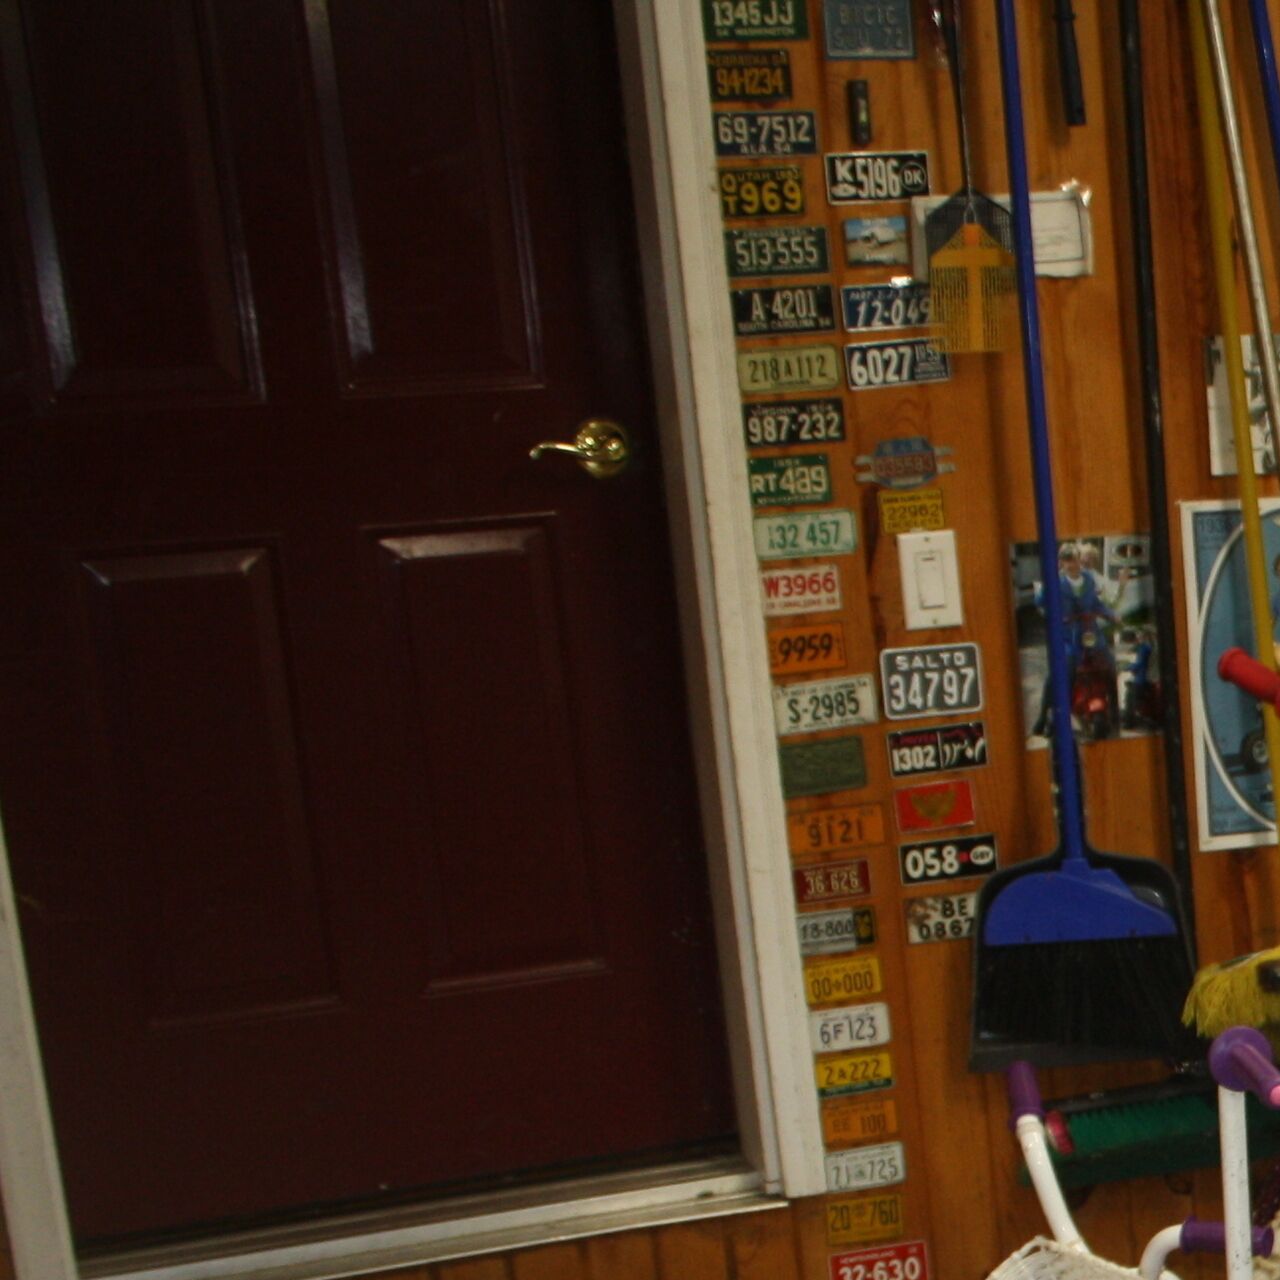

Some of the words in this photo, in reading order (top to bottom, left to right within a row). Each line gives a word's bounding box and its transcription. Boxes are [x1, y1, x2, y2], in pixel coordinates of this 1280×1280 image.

[717, 114, 811, 145] 69-7512
[855, 157, 902, 199] 5196
[903, 168, 924, 184] DK
[740, 179, 802, 215] 969
[850, 345, 913, 387] 6027
[778, 465, 828, 495] 489
[762, 572, 837, 598] W3966
[895, 652, 967, 671] SALTO
[889, 667, 976, 711] 34797
[787, 690, 861, 724] S-2985
[891, 744, 938, 771] 1302
[904, 845, 961, 879] 058
[941, 897, 969, 919] BE
[918, 918, 976, 941] 0867
